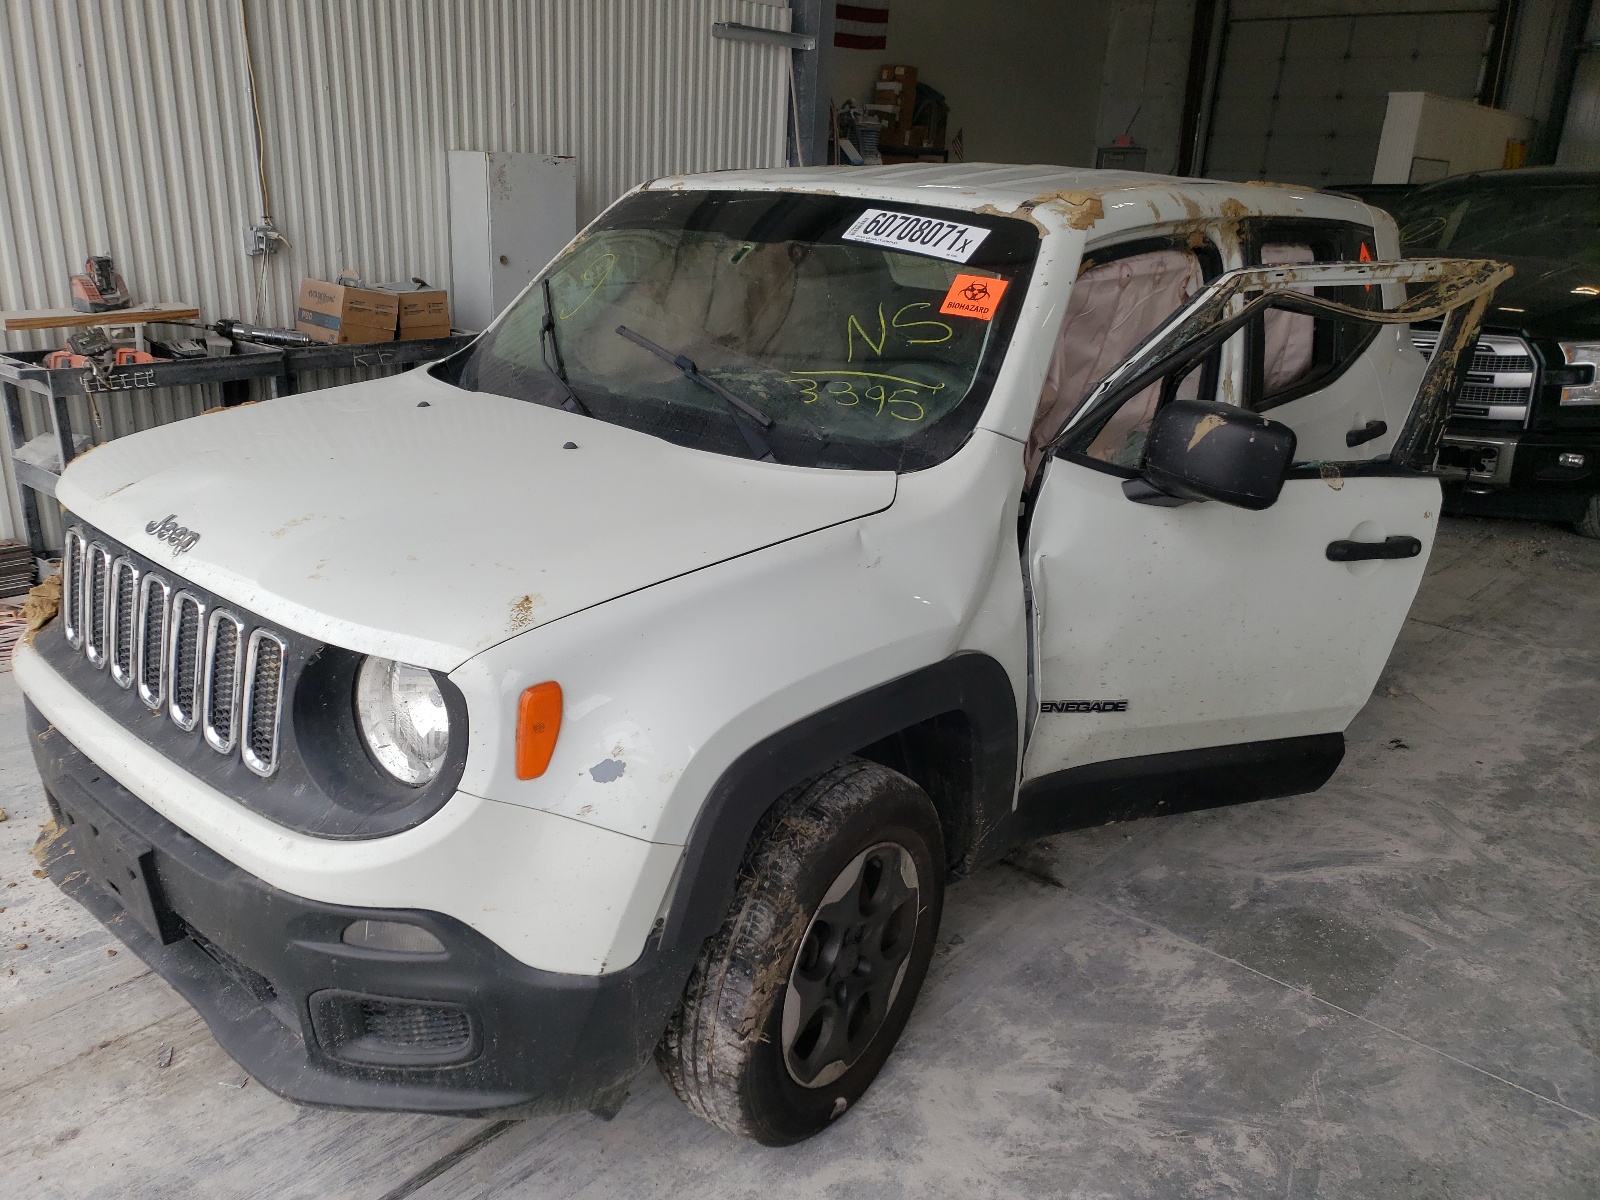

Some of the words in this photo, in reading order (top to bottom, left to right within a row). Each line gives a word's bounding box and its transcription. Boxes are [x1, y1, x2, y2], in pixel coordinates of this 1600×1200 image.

[947, 301, 990, 314] BIOHAZARD
[784, 378, 924, 421] 3395
[145, 514, 200, 557] Jeep
[1040, 699, 1128, 714] ENEGADE
